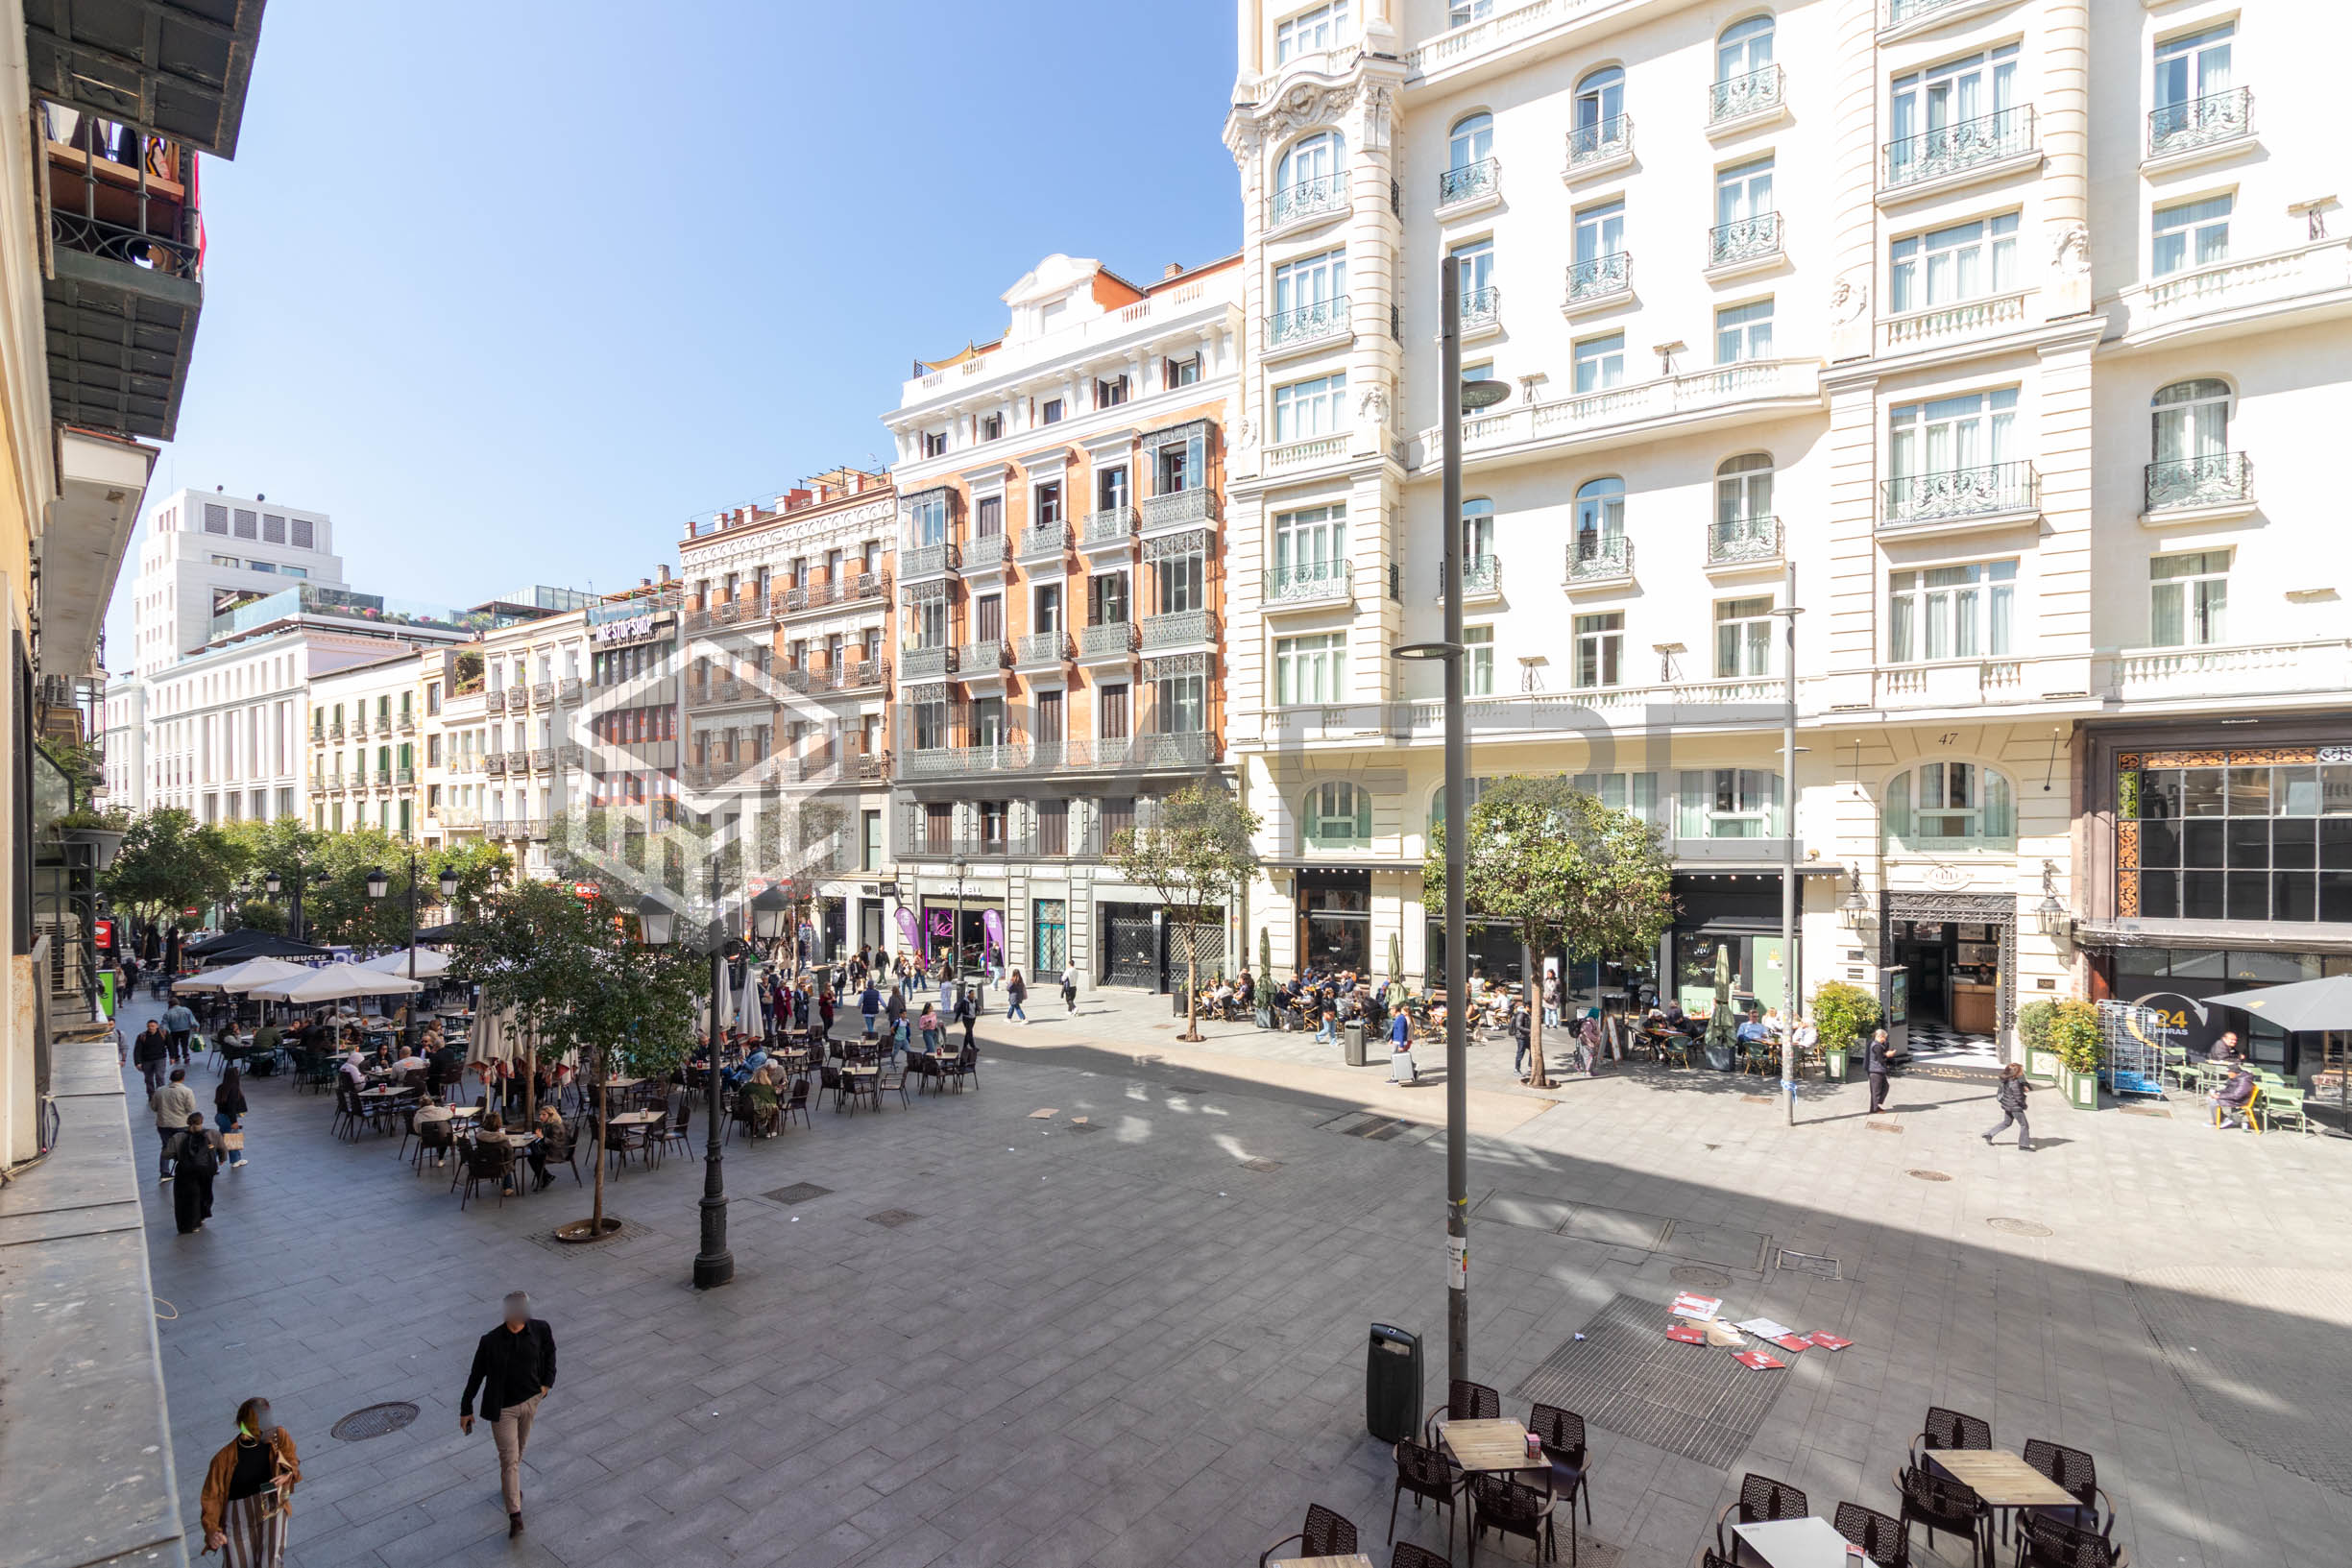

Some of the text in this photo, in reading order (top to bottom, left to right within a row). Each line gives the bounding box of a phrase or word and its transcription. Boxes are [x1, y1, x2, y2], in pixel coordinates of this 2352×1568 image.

[596, 616, 652, 641] ONE STOP SHOP
[1938, 733, 1959, 745] 47
[2155, 1009, 2188, 1028] 24
